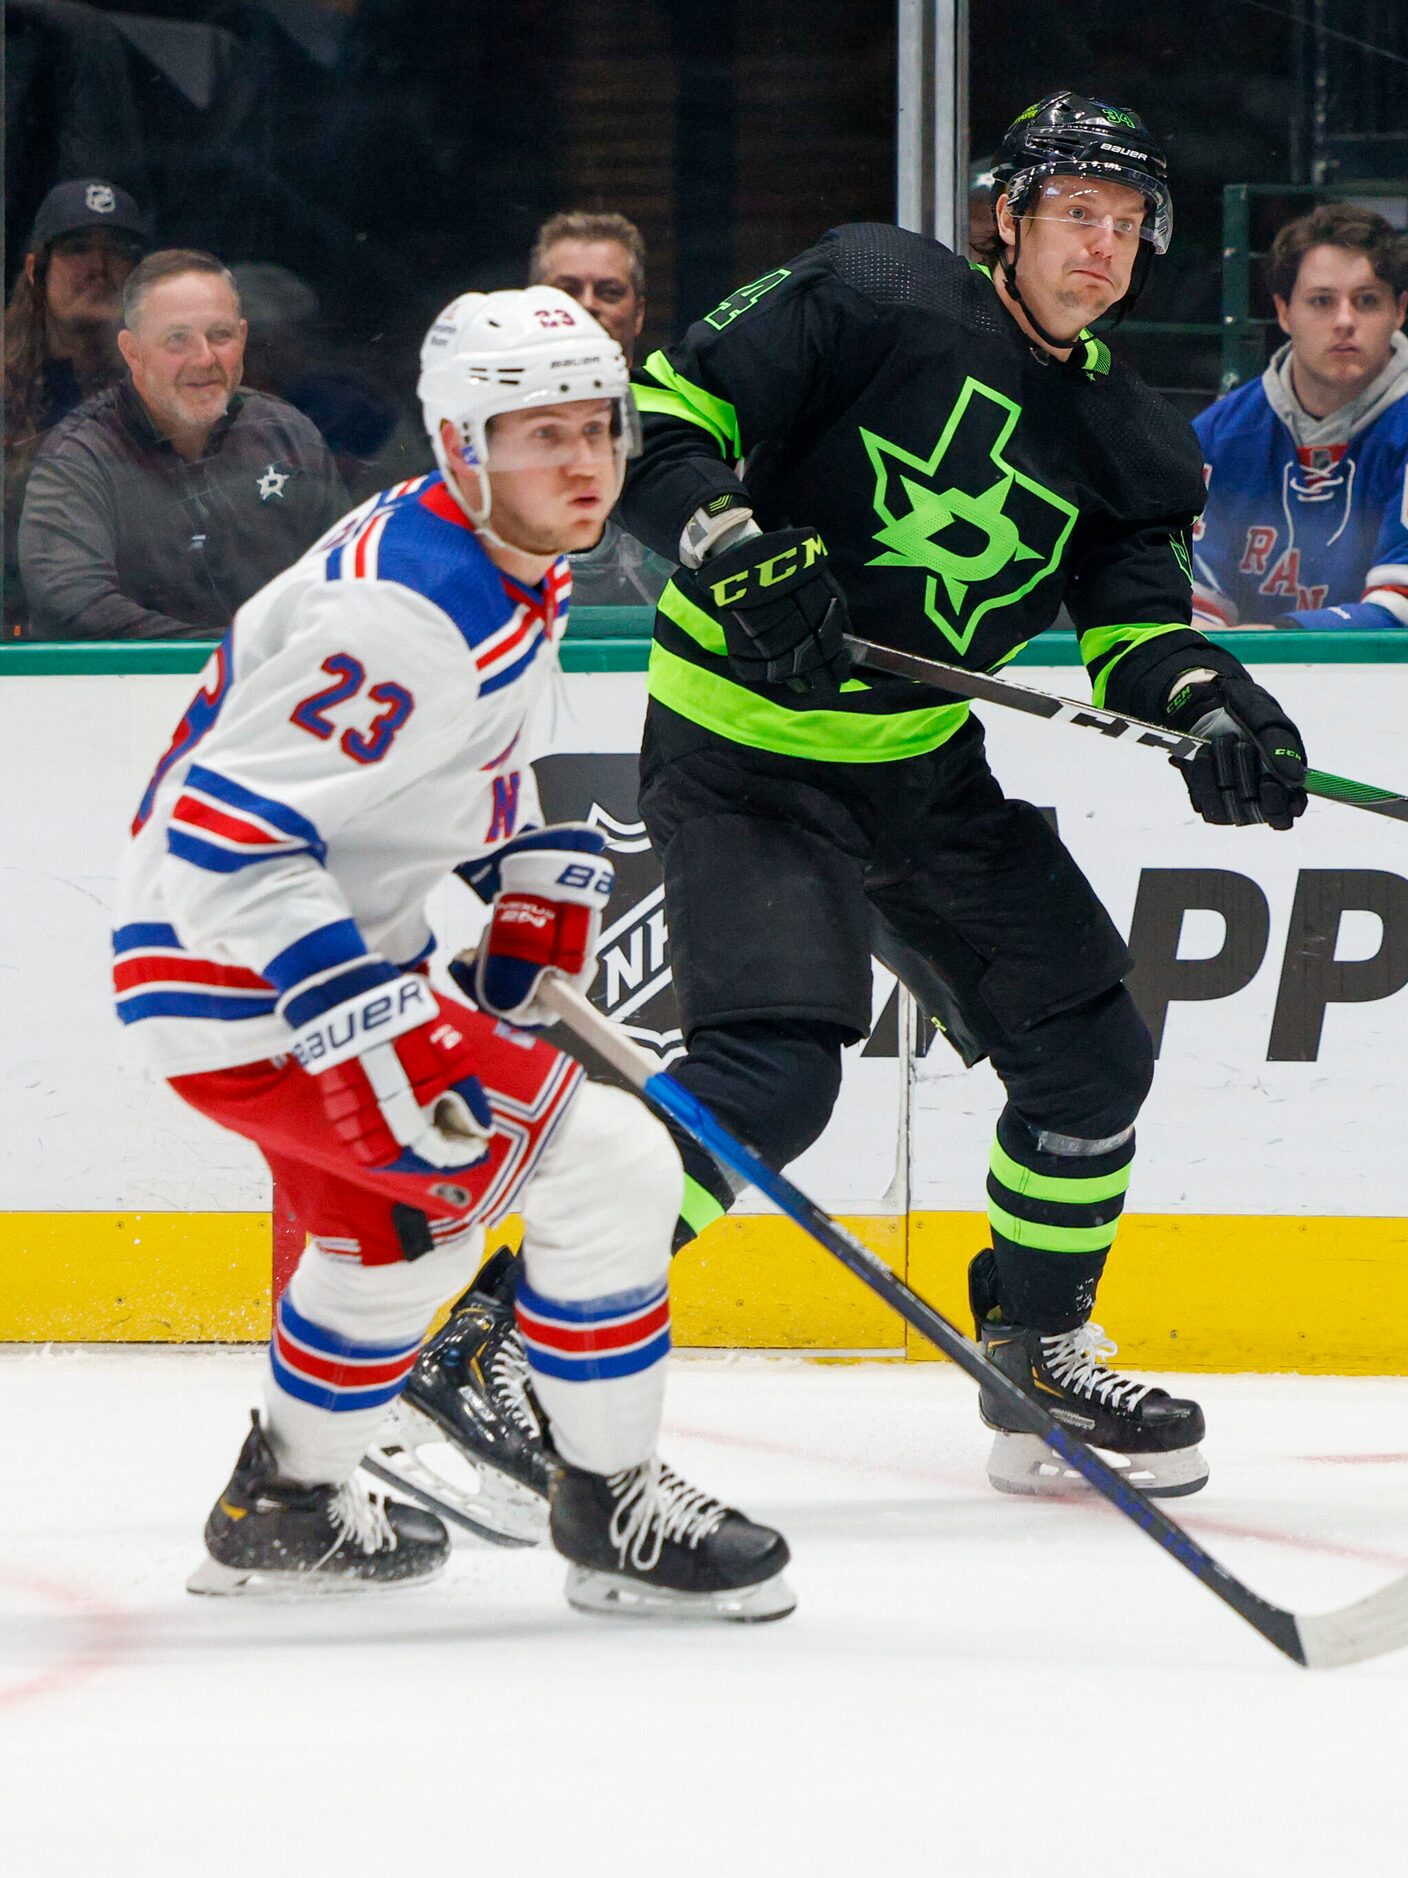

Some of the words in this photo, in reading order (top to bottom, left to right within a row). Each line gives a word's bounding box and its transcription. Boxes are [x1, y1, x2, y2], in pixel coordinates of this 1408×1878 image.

[1099, 142, 1149, 162] BAUER
[533, 309, 577, 328] 23
[708, 533, 829, 608] CCM
[288, 651, 415, 766] 23
